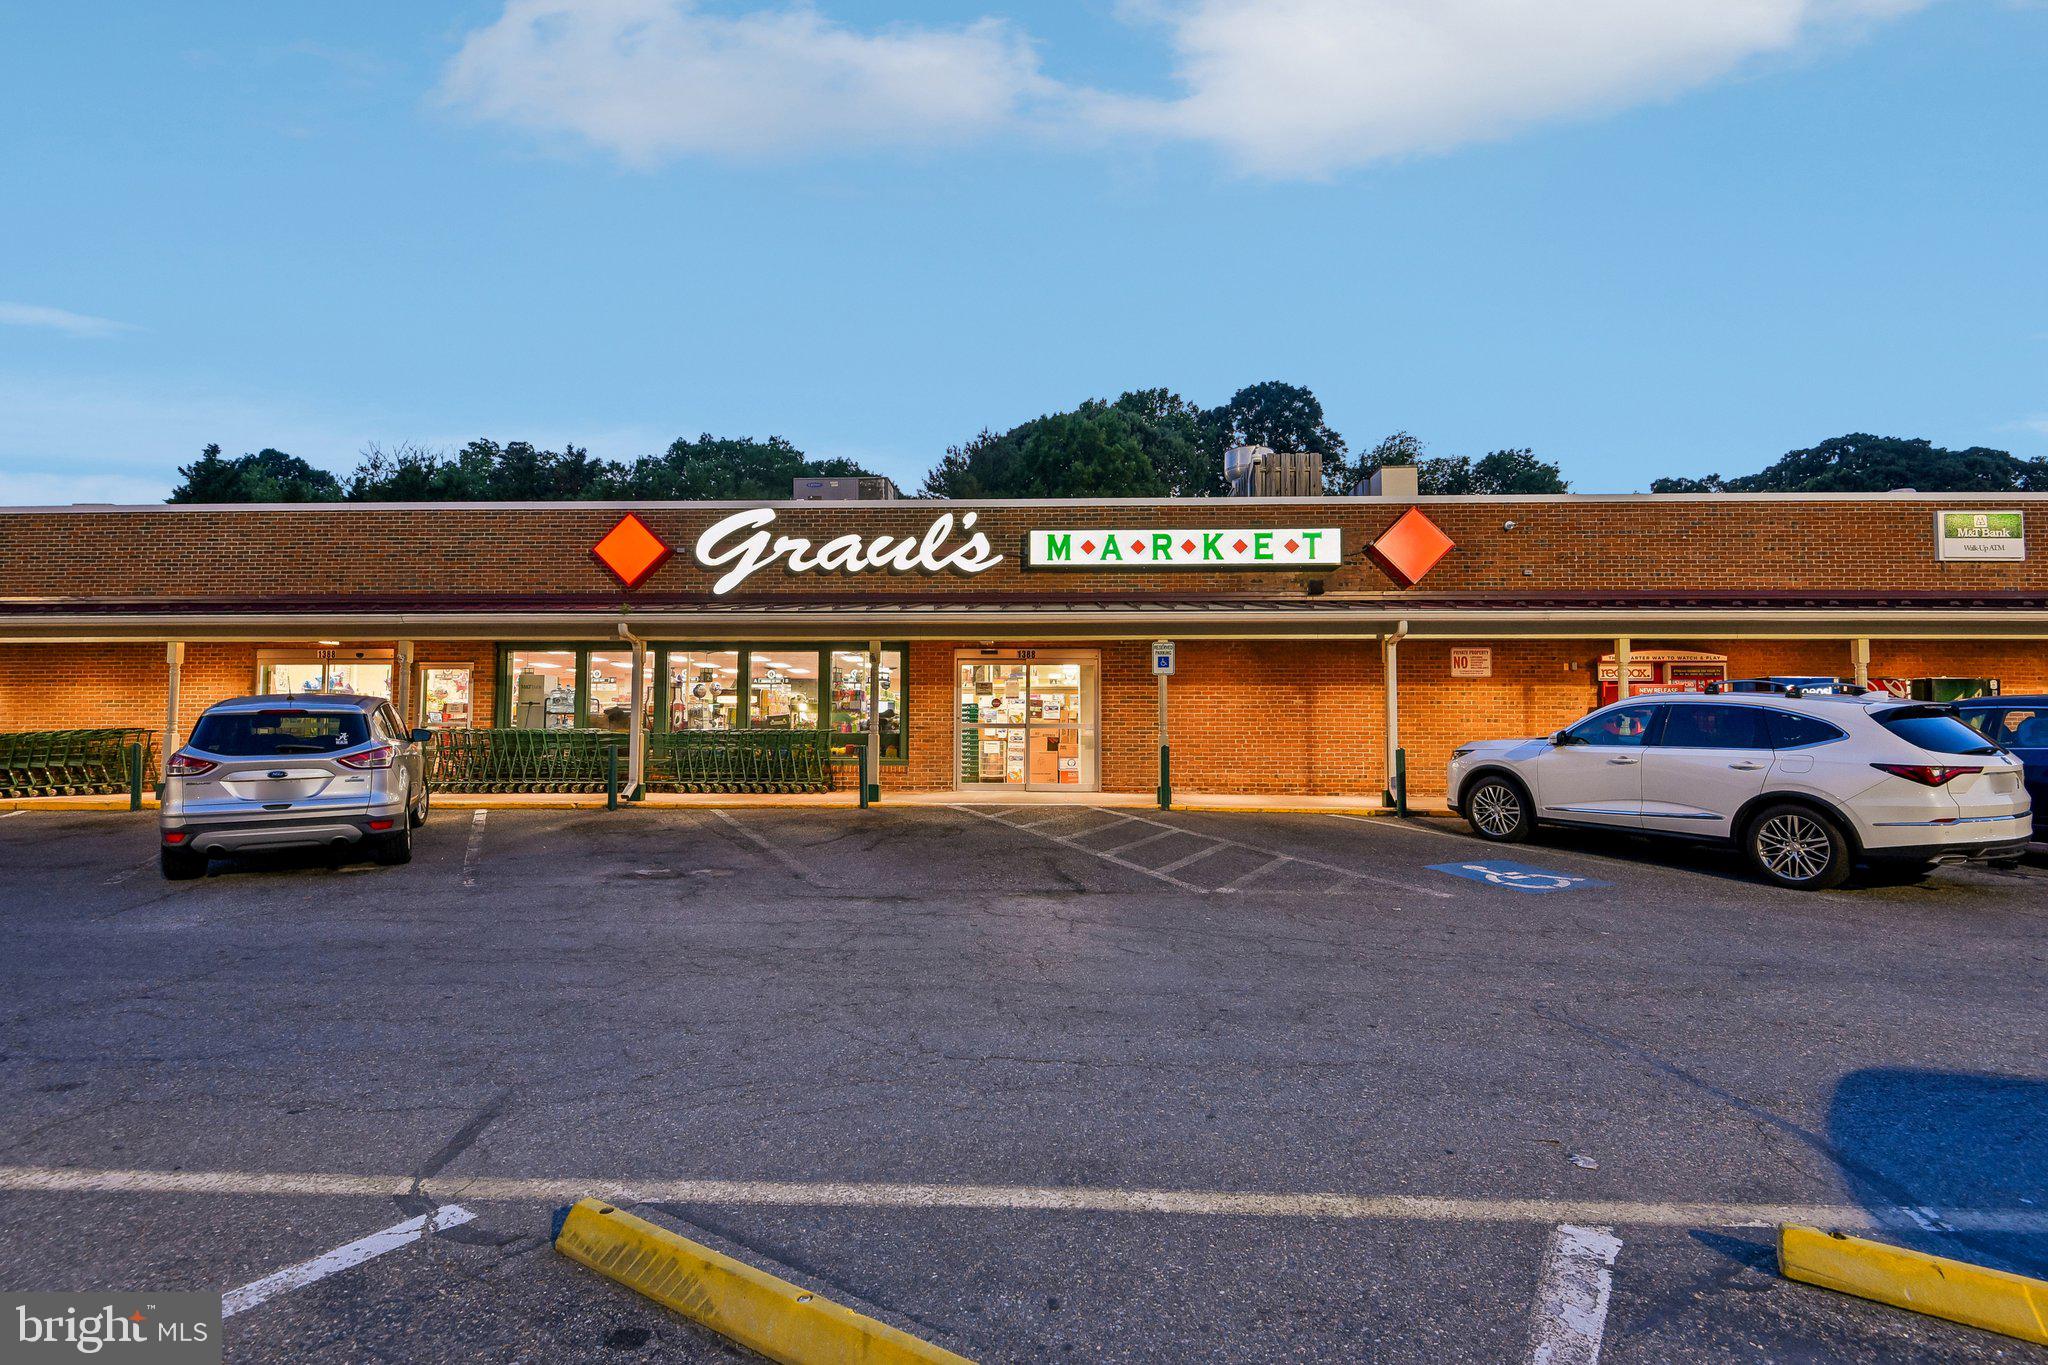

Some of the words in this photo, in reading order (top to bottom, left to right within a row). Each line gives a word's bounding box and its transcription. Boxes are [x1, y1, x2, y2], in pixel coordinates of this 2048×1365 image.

[1957, 527, 1980, 537] M&T
[1982, 527, 2011, 537] Bank
[696, 508, 1004, 595] Graul's
[1963, 544, 1988, 552] Walk-Up
[1017, 650, 1036, 659] 1388
[1453, 656, 1468, 669] NO
